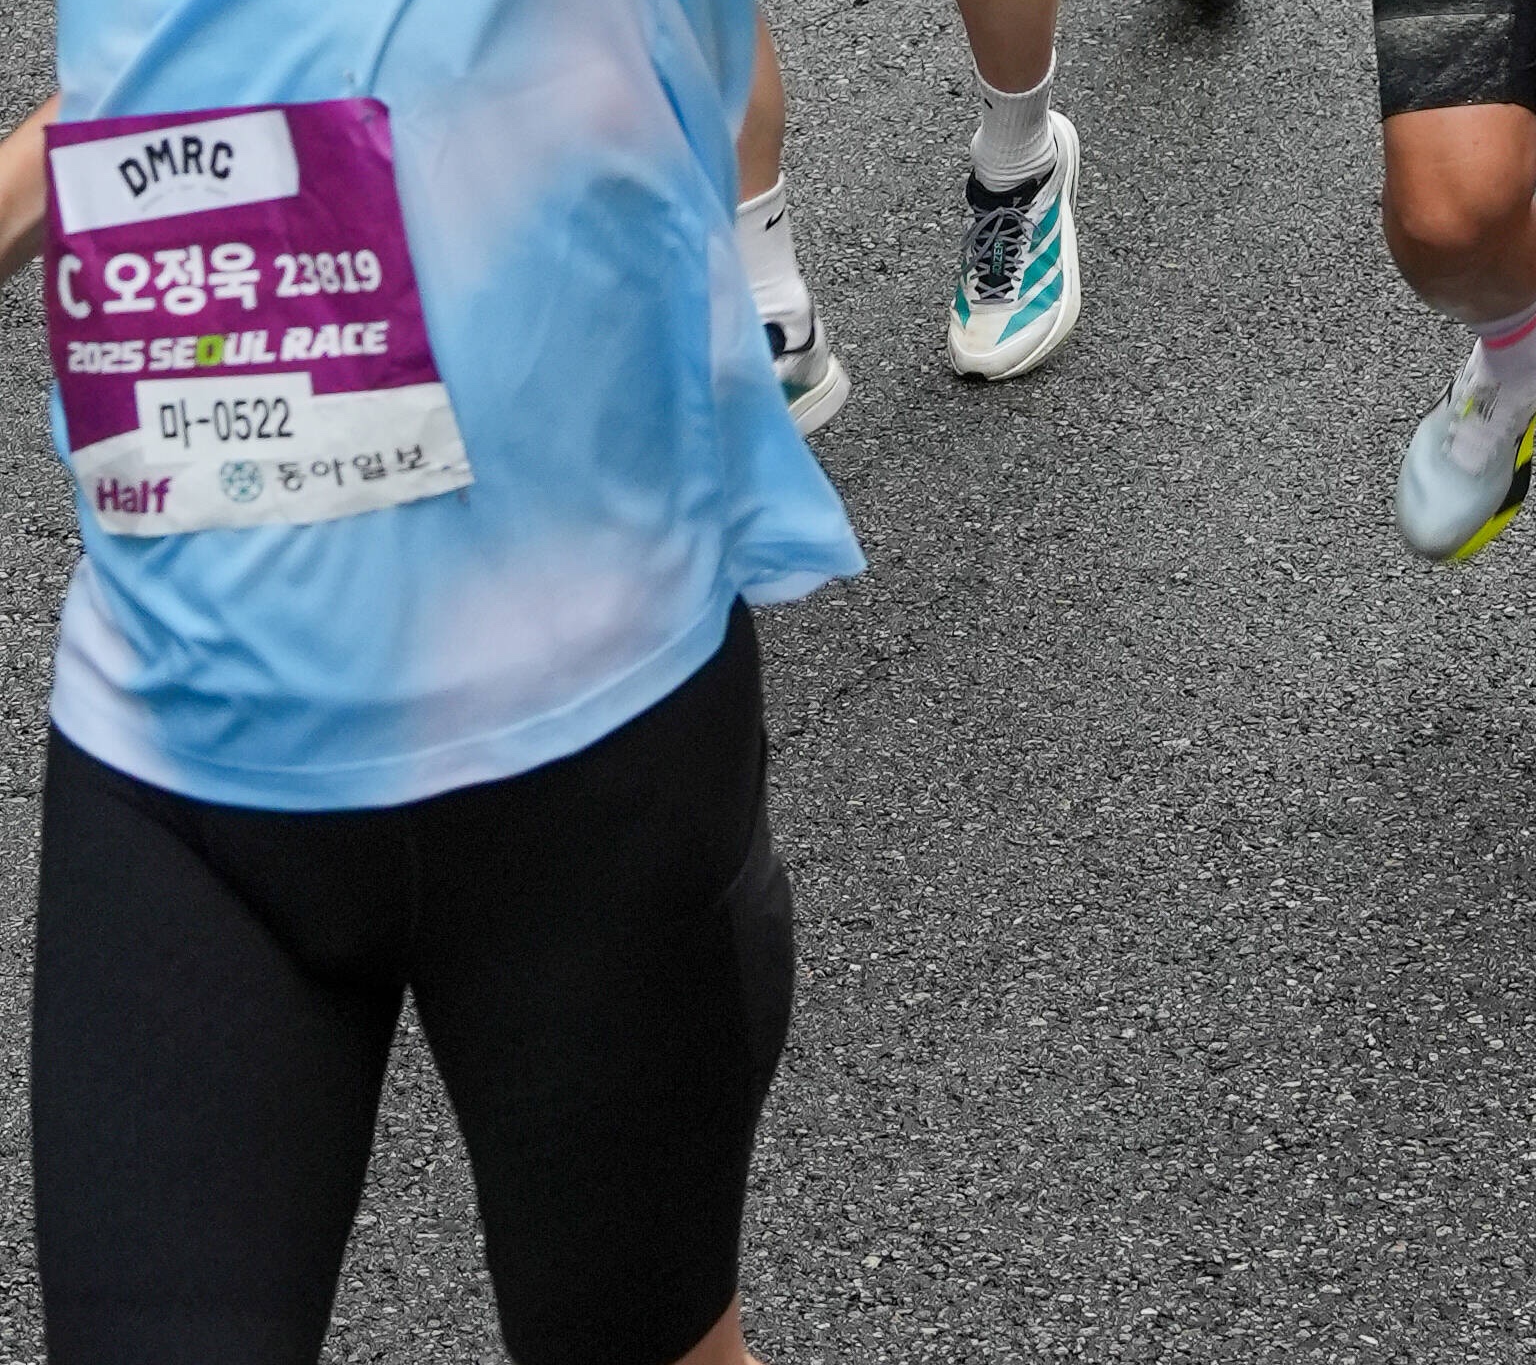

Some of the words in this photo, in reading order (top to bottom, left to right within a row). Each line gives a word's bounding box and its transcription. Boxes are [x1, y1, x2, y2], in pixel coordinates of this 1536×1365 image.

[117, 134, 235, 198] DMRC
[57, 253, 92, 320] C
[102, 242, 262, 317] 오정욱
[273, 248, 383, 298] 23819
[67, 339, 148, 374] 2025
[147, 333, 278, 373] SEOUL
[280, 320, 389, 363] RACE
[159, 396, 293, 449] 마-0522
[277, 443, 430, 492] 동아일보
[96, 476, 172, 515] Half
